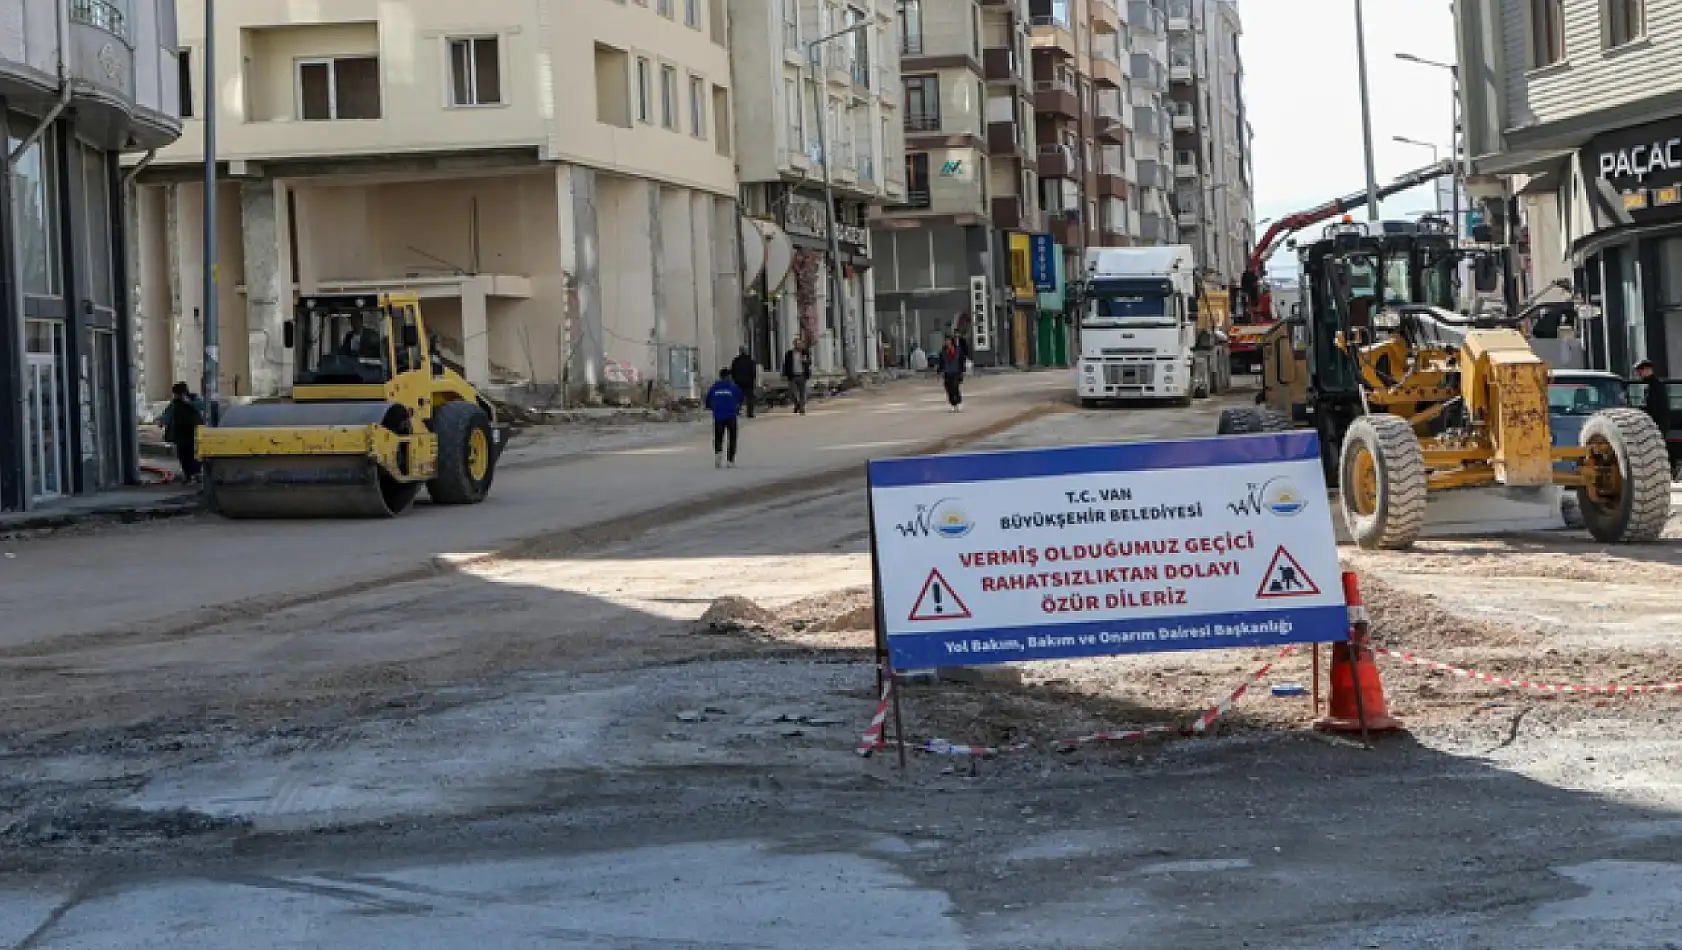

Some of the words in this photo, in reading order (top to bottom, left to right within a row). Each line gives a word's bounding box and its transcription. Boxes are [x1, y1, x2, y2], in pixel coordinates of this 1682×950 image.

[1064, 490, 1097, 504] T.C.
[1098, 487, 1132, 501] VAN
[1000, 506, 1107, 530] BÜYÜKŞEHİR
[1110, 500, 1203, 522] BELEDİYESİ
[959, 544, 1040, 568] VERMİŞ
[1044, 538, 1182, 562] OLDUĞUMUZ
[1184, 530, 1254, 556] GEÇİCİ
[981, 566, 1159, 592] RAHATSIZLIKTAN
[1163, 560, 1240, 580] DOLAYI
[1041, 593, 1100, 613] ÖZÜR
[1105, 586, 1187, 609] DİLERİZ
[945, 638, 969, 653] Yol
[1028, 633, 1075, 648] Bakım
[1079, 634, 1097, 645] ve
[1099, 627, 1156, 643] Onarım
[1158, 622, 1211, 640] Dairesi
[1213, 618, 1293, 637] Başkanlığı
